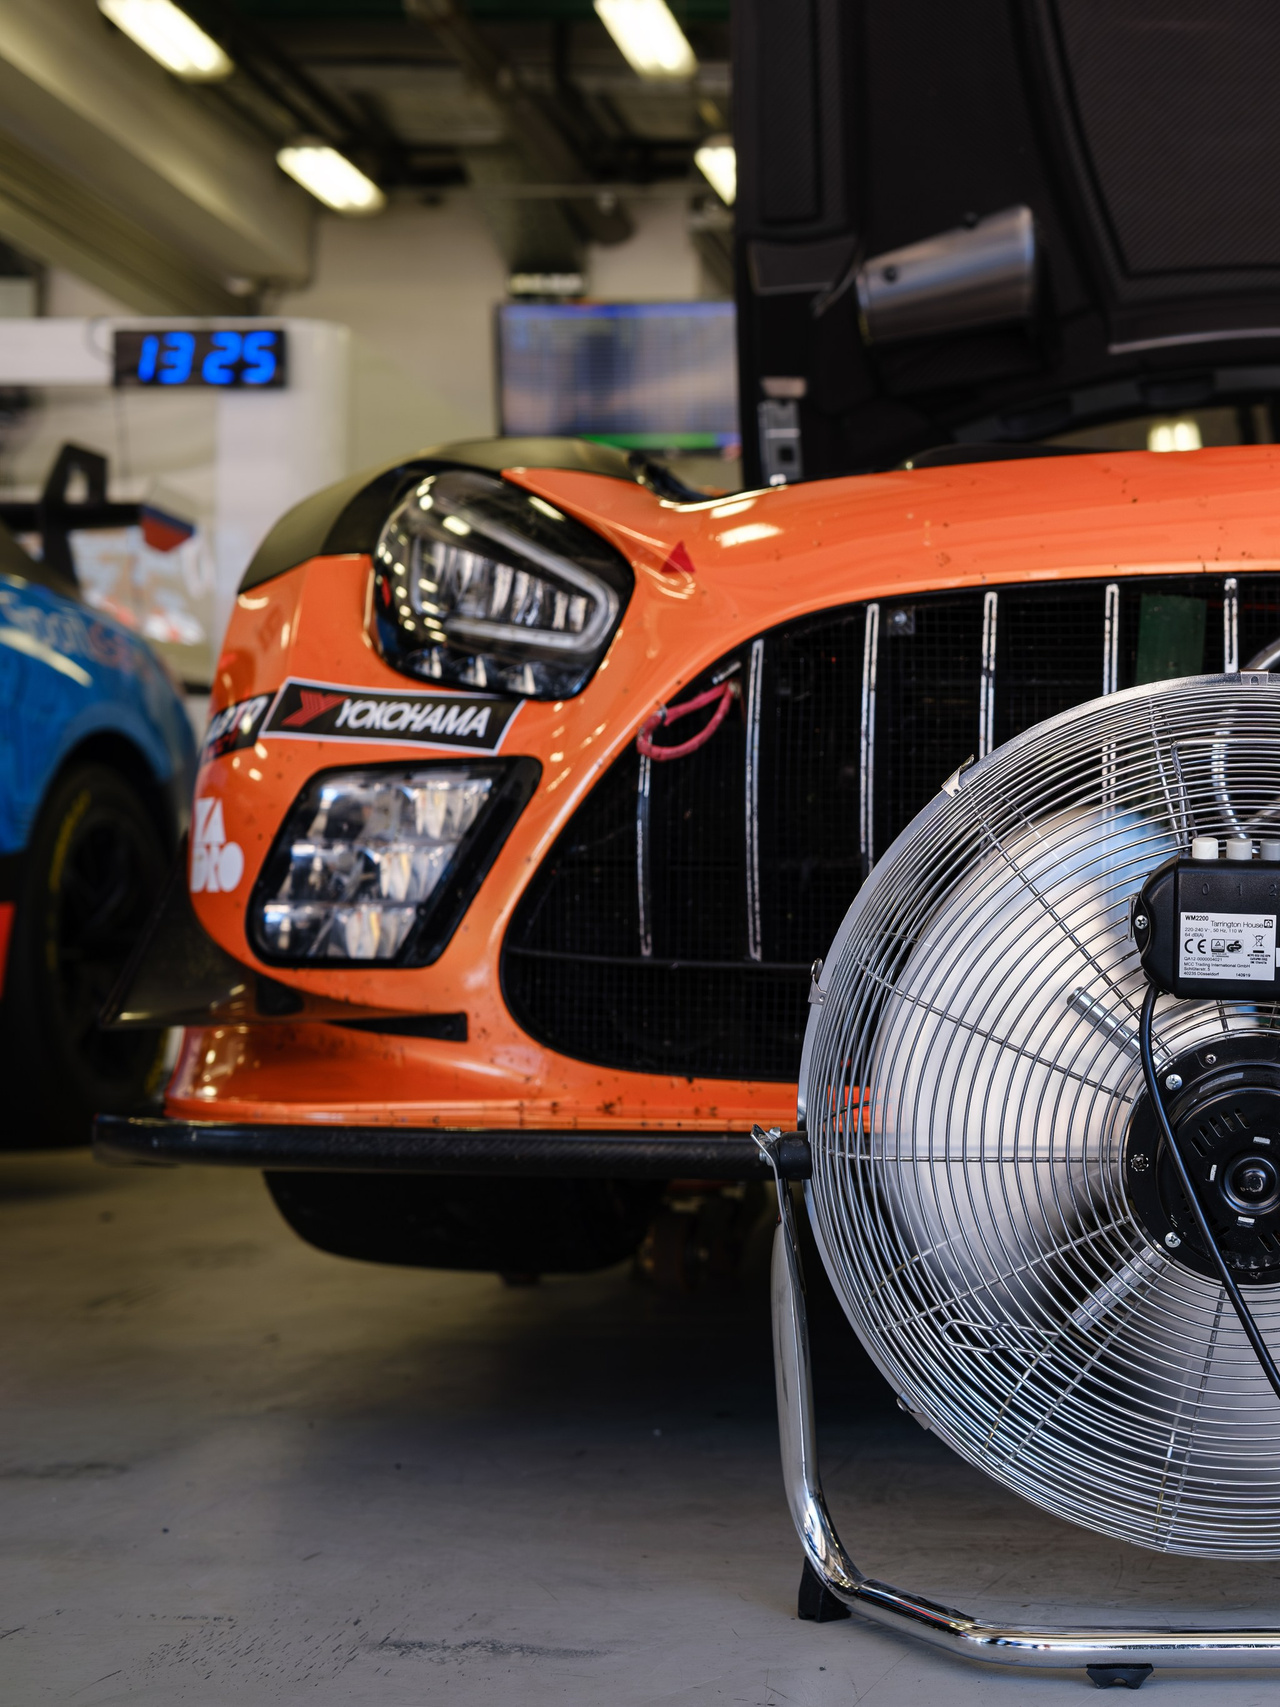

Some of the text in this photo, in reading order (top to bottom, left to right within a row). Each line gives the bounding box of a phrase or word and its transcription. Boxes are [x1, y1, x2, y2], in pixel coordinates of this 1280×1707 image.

[334, 698, 492, 738] YOKOHAMA
[1211, 920, 1264, 929] Tarrington House
[1184, 938, 1207, 954] CE
